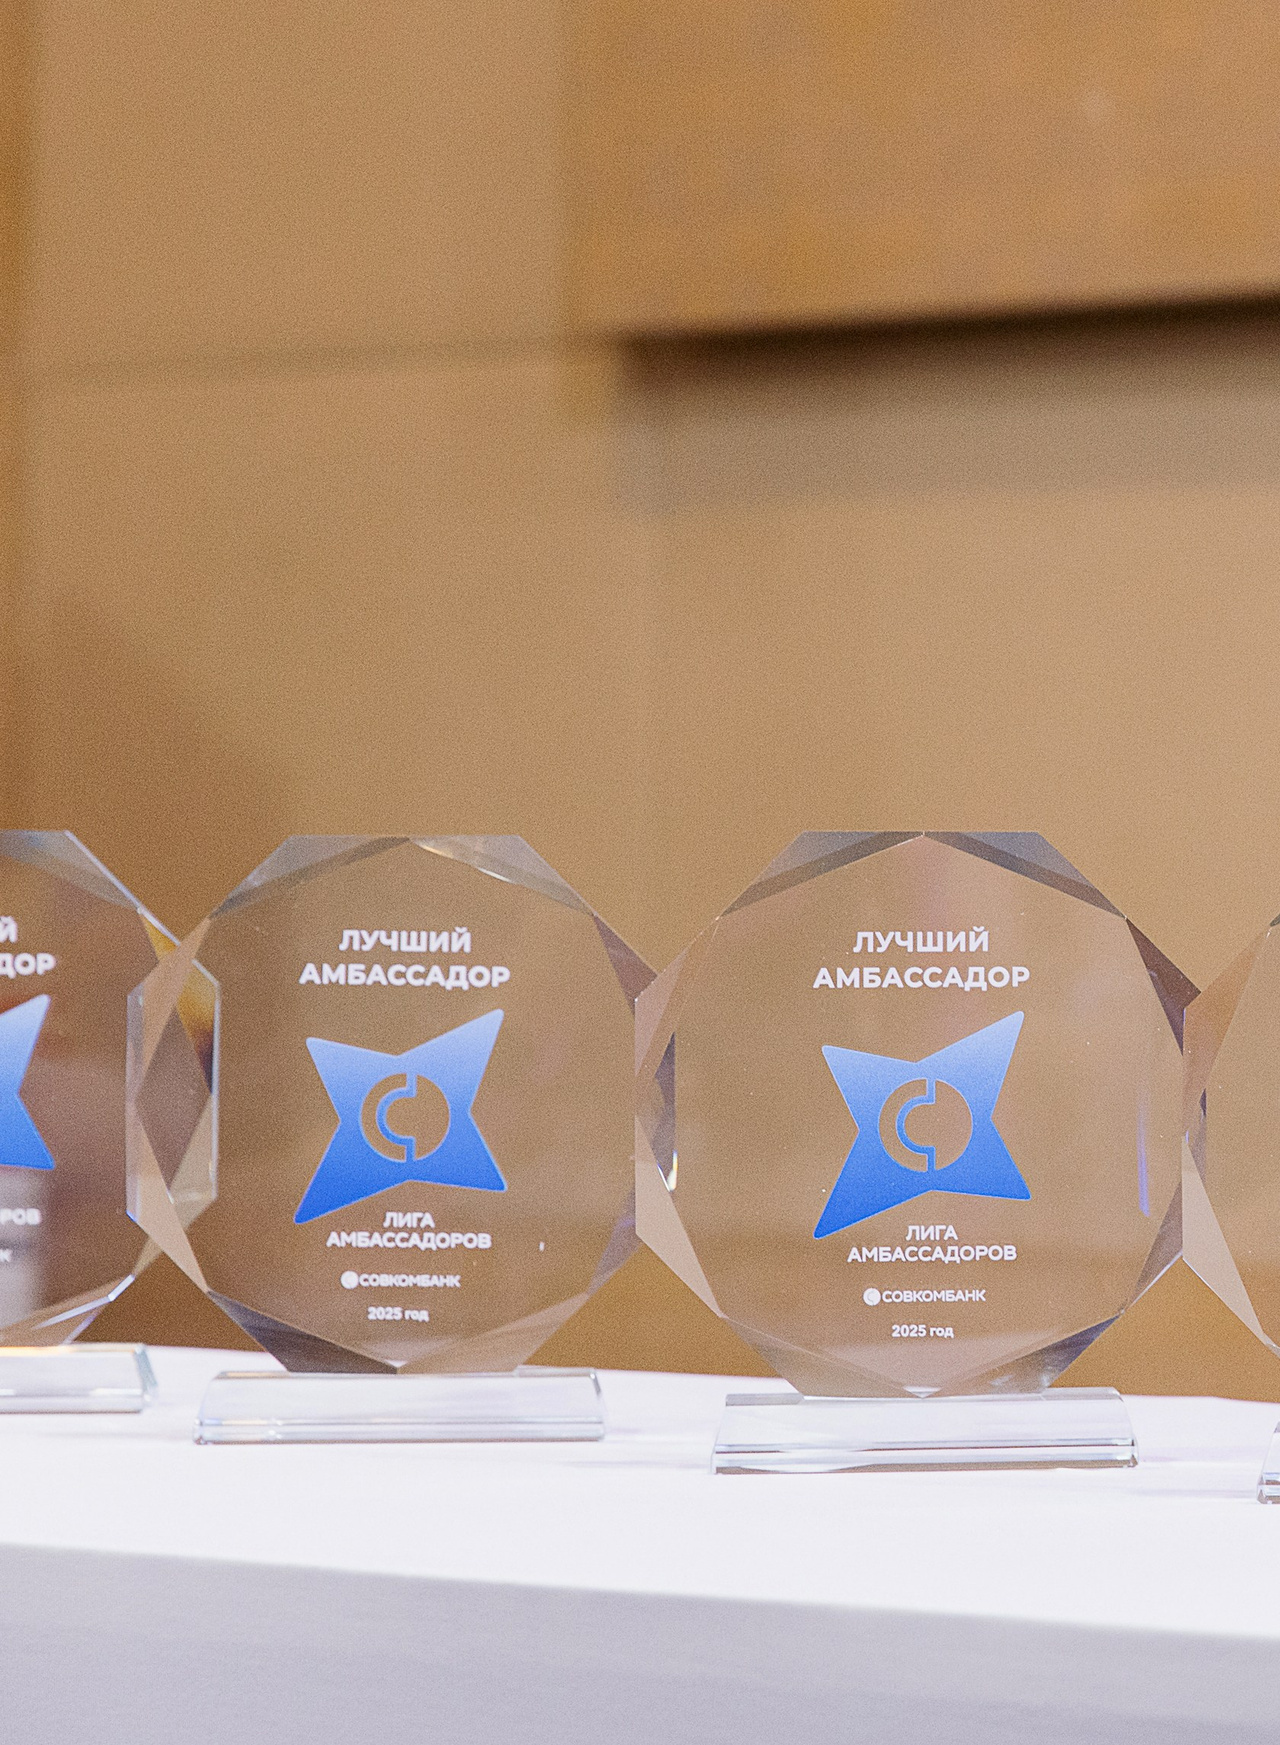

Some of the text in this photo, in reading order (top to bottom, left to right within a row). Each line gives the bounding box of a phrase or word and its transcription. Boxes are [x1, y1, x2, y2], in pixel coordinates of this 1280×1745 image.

[338, 926, 472, 954] ЛУЧШИЙ
[852, 925, 989, 953] ЛУЧШИЙ
[299, 962, 511, 991] АМБАССАДОР
[812, 965, 1031, 992] АМБАССАДОР
[383, 1211, 436, 1228] ЛИГА
[326, 1230, 492, 1251] АМБАССАДОРОВ
[905, 1224, 959, 1241] ЛИГА
[847, 1244, 1018, 1264] АМБАССАДОРОВ
[358, 1273, 461, 1288] СОВКОМБАНК
[880, 1289, 986, 1303] СОВКОМБАНК
[367, 1306, 430, 1322] 2025 год
[891, 1324, 955, 1339] 2025 год
